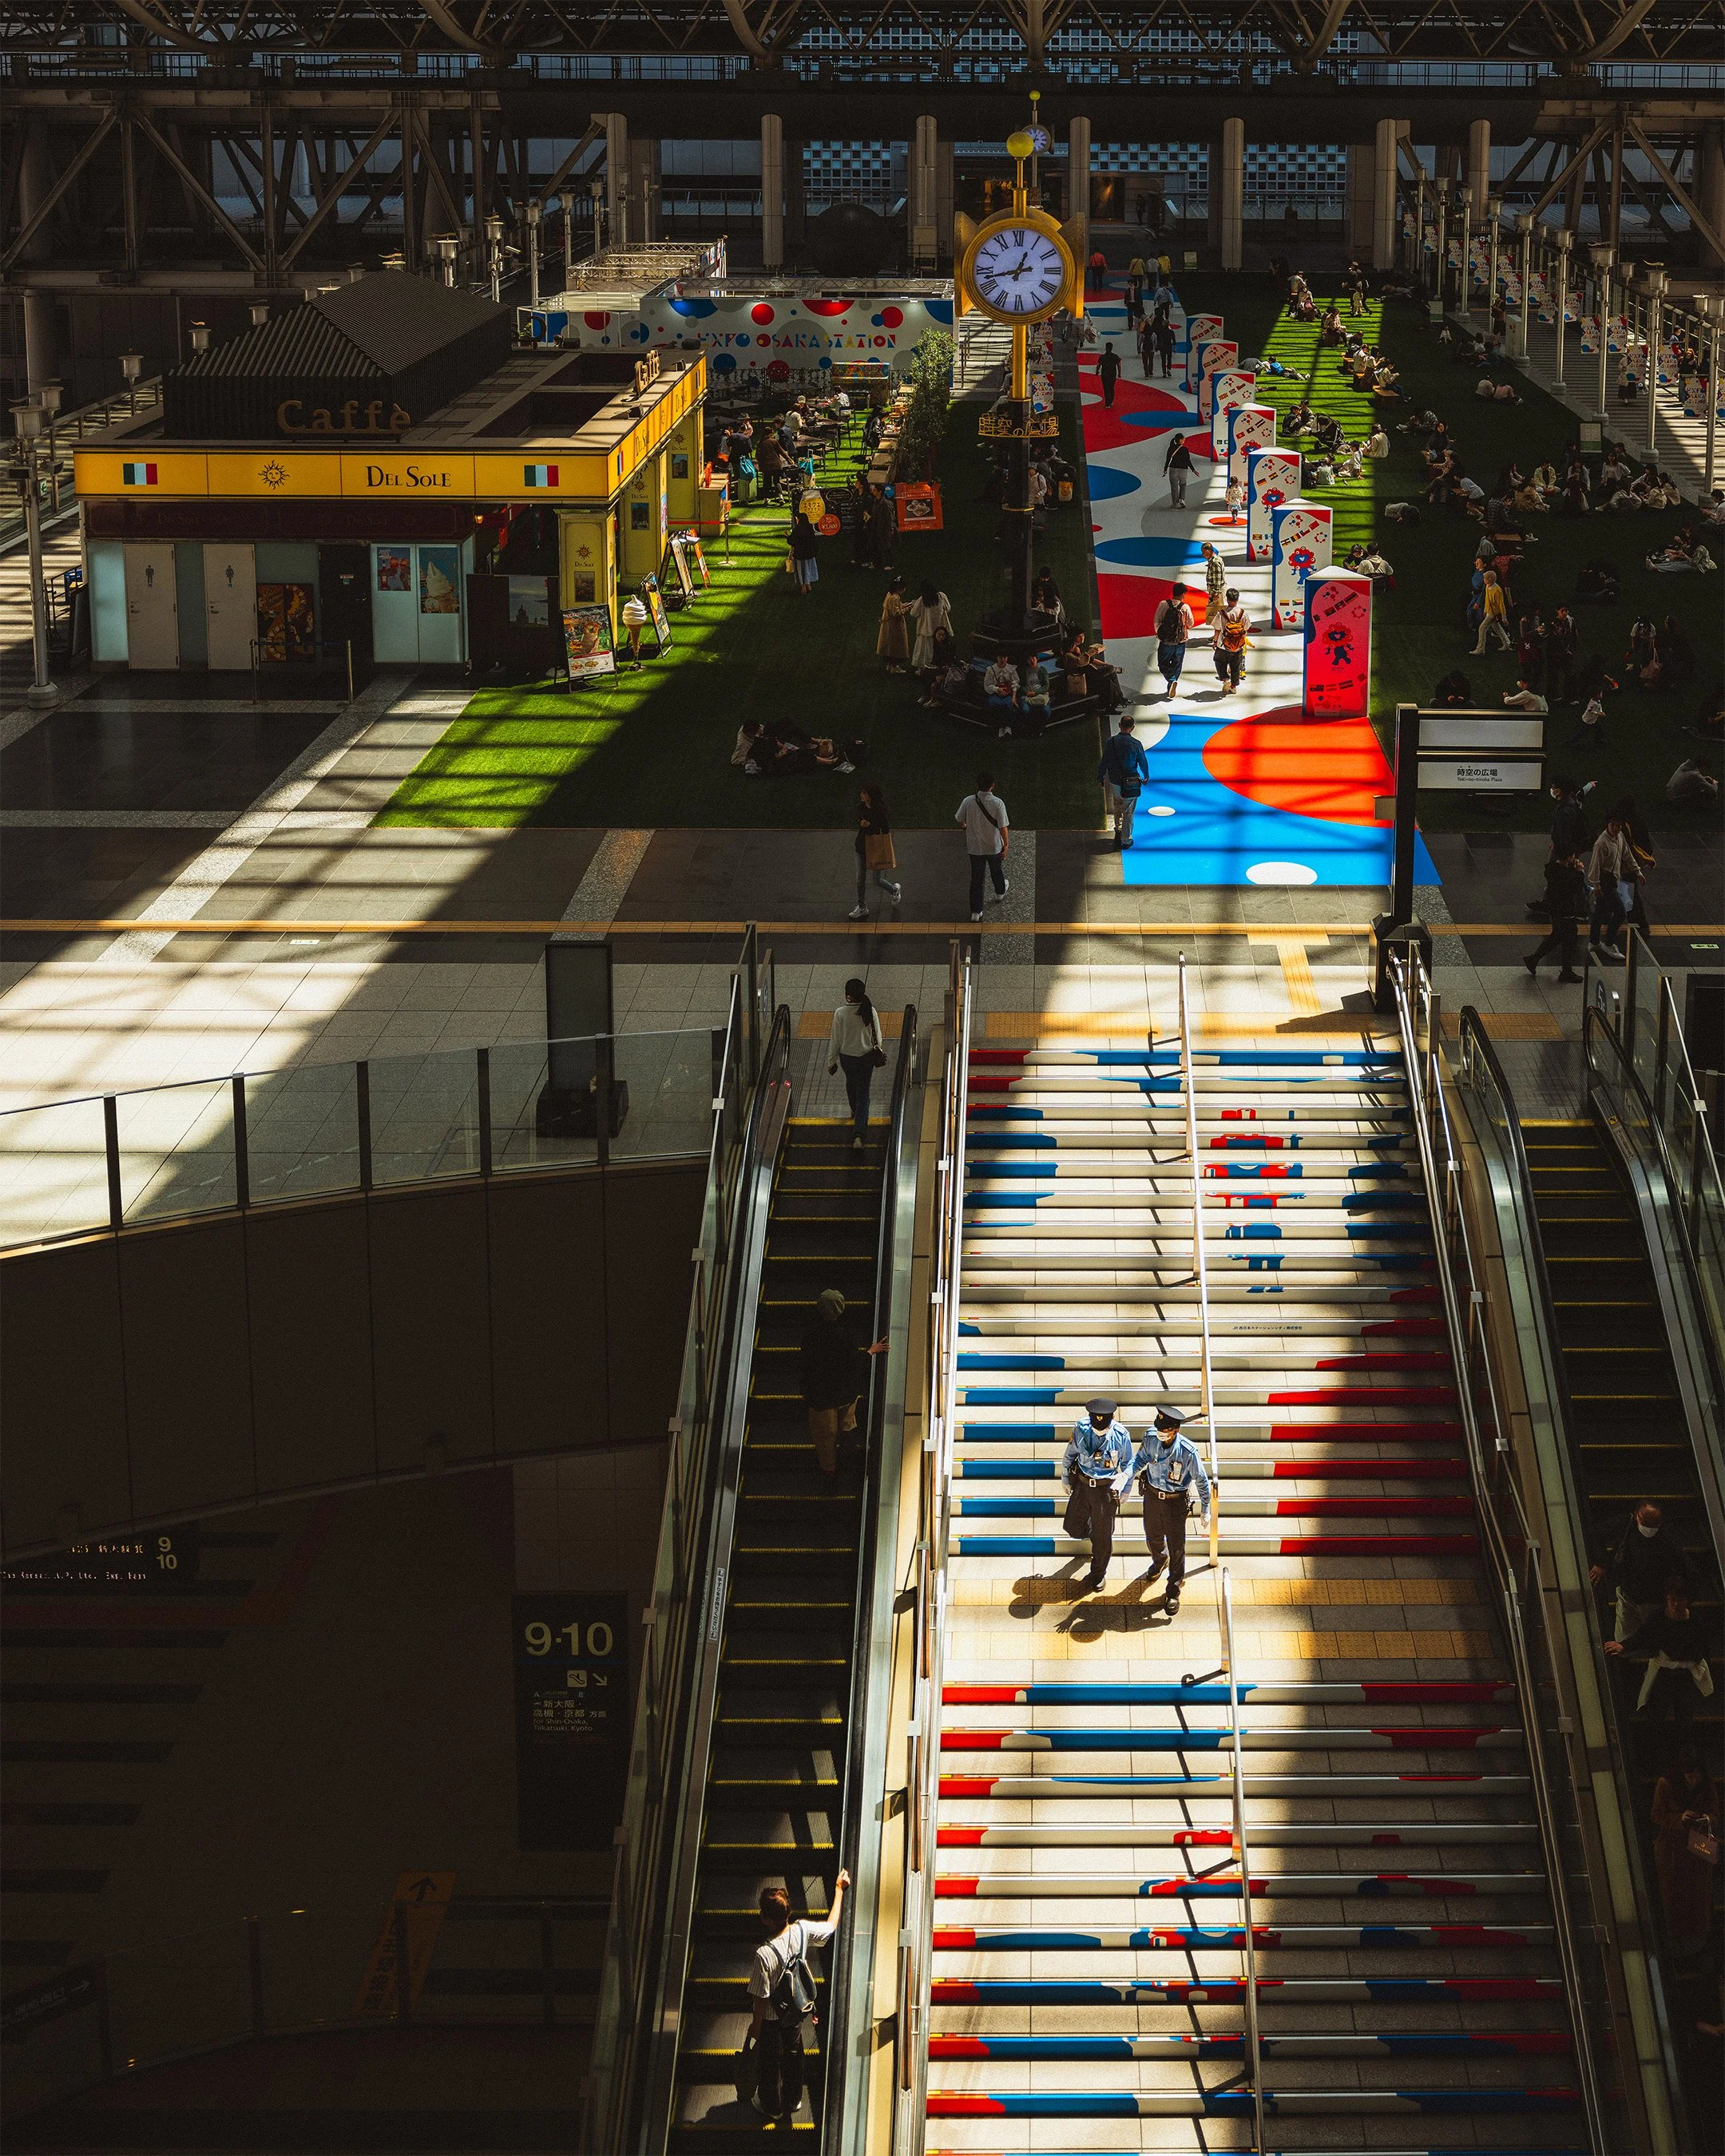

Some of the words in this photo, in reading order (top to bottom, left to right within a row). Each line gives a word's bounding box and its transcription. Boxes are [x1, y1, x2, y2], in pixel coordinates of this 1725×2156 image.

[756, 333, 821, 348] OSAKA
[823, 333, 896, 348] STATION
[276, 400, 412, 433] Caffè
[158, 1537, 172, 1552] 9
[157, 1555, 177, 1570] 10
